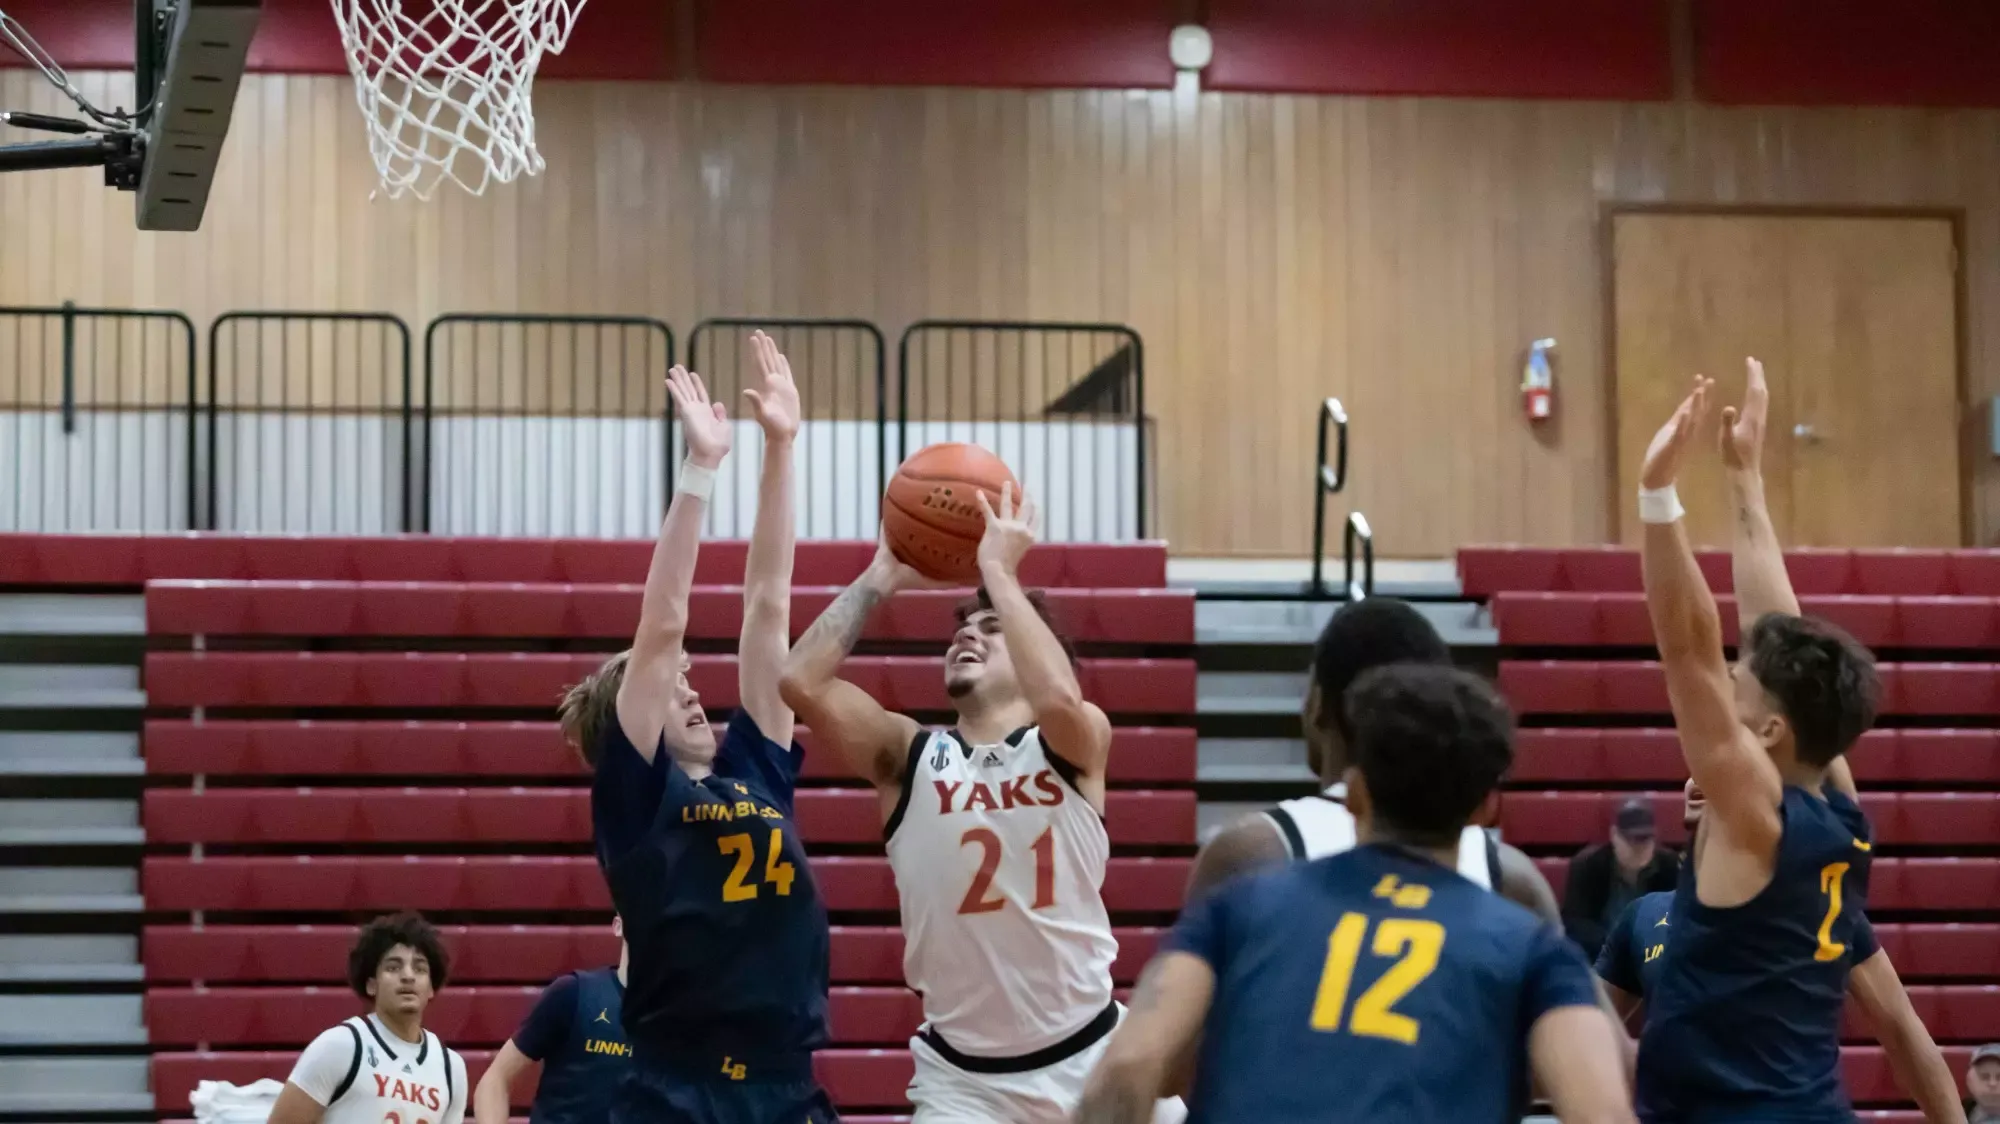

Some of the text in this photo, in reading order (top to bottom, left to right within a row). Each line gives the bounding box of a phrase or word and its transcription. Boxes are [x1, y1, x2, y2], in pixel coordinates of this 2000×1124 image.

[932, 769, 1065, 815] YAKS
[717, 828, 795, 902] 24
[957, 826, 1056, 915] 21
[1310, 911, 1446, 1046] 12
[585, 1039, 633, 1058] LINN-
[372, 1073, 440, 1112] YAKS
